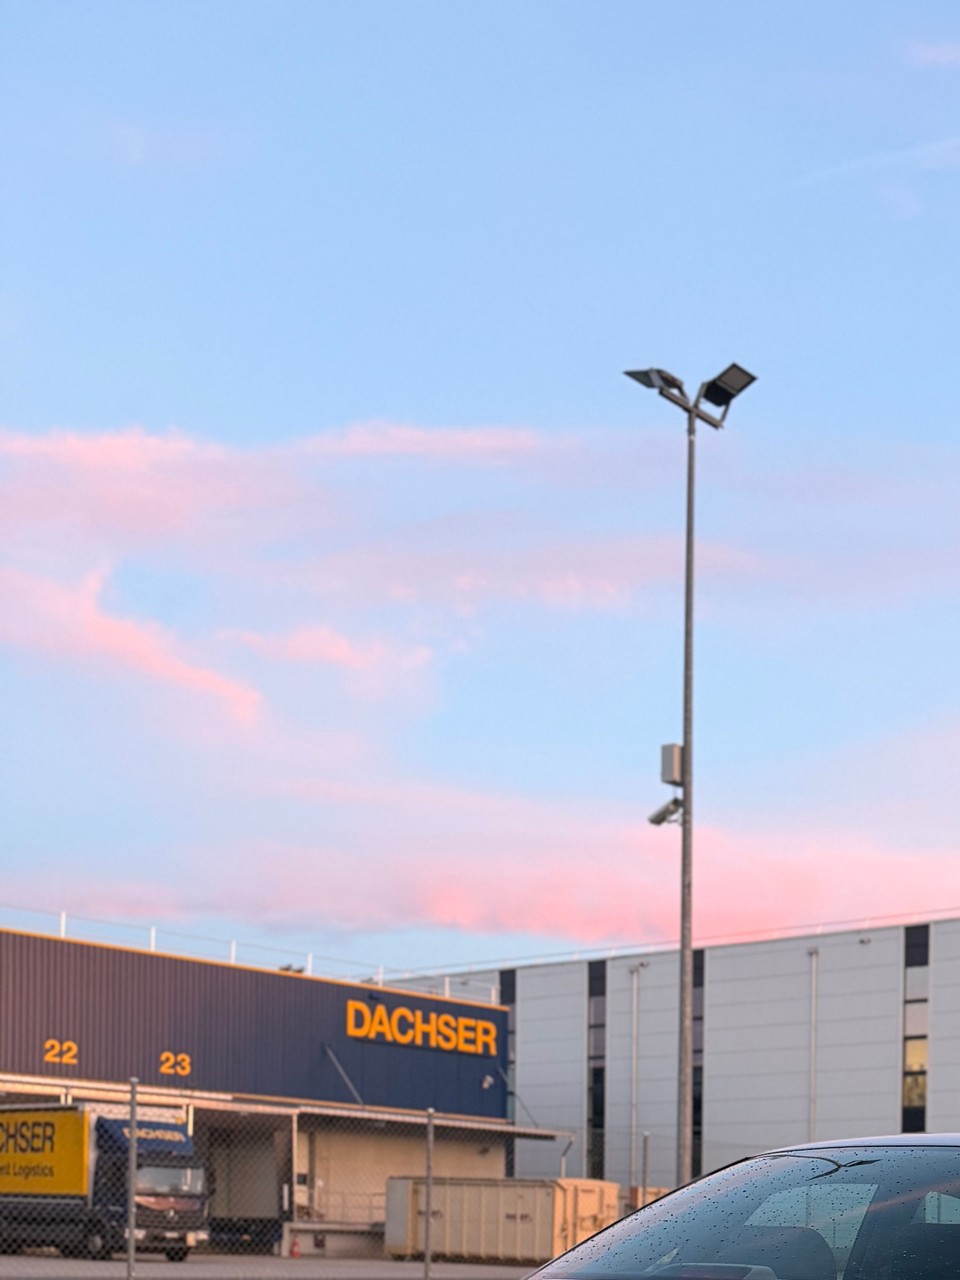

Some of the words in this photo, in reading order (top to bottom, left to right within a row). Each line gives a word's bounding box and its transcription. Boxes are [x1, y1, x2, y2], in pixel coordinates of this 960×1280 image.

[347, 1000, 497, 1056] DACHSER
[44, 1039, 78, 1065] 22
[159, 1051, 192, 1076] 23
